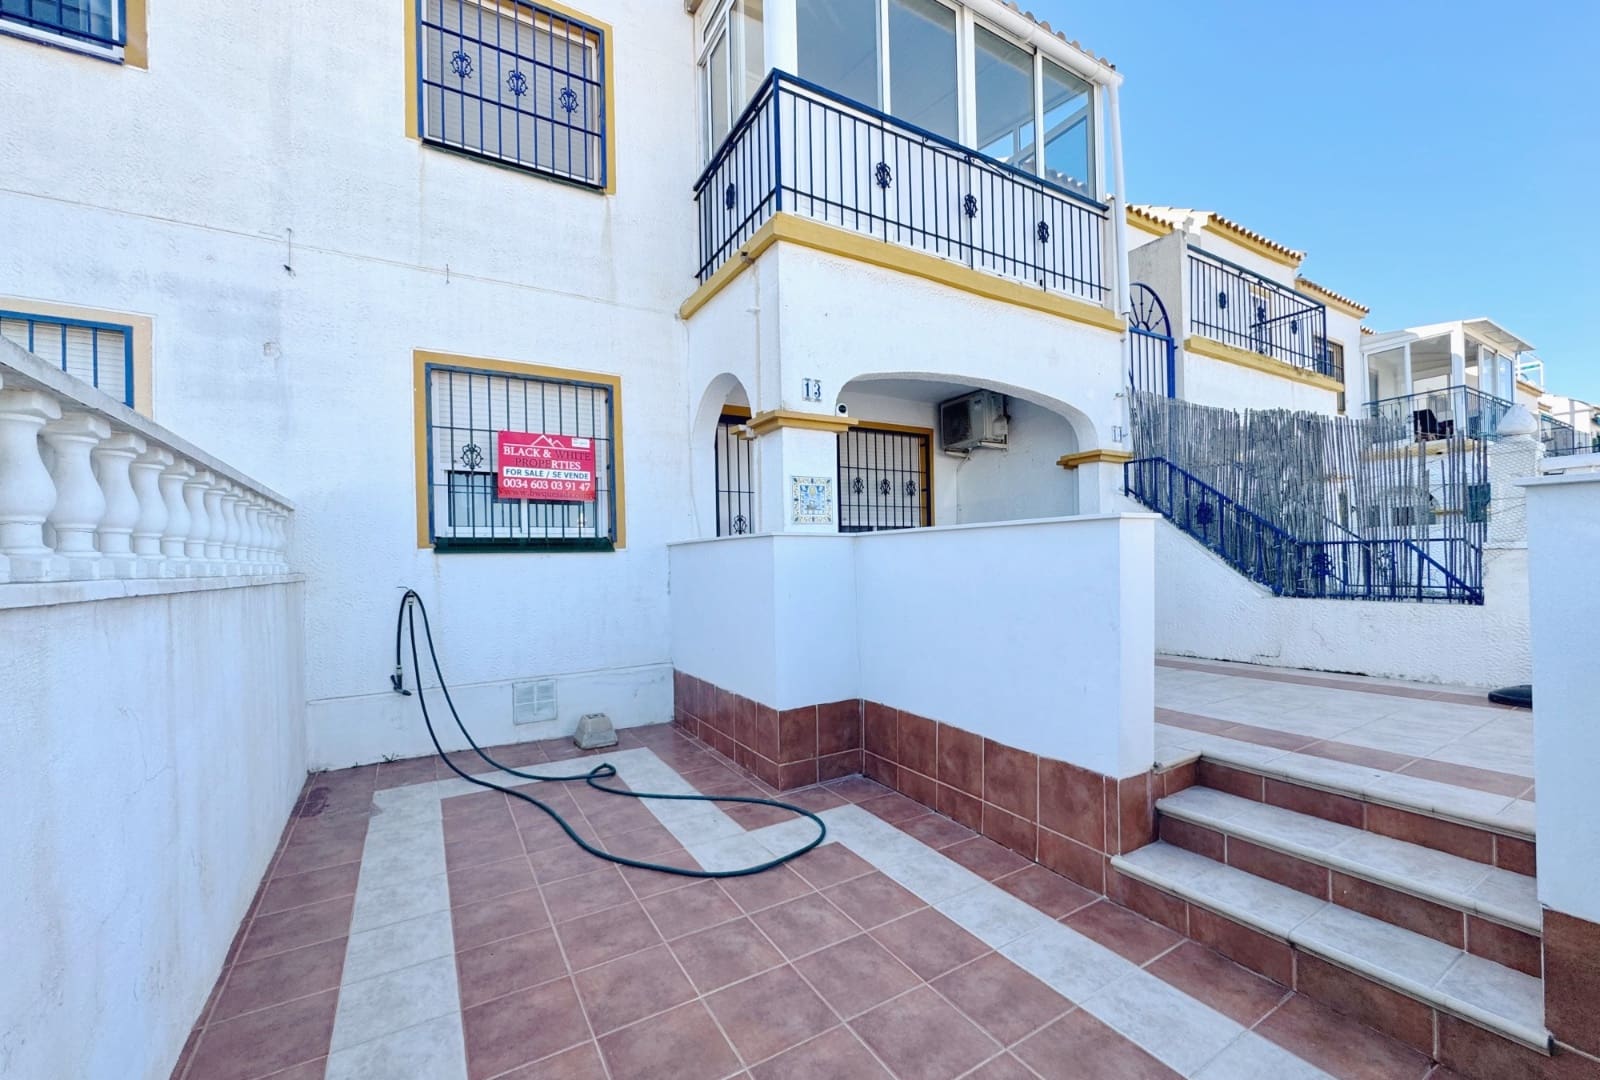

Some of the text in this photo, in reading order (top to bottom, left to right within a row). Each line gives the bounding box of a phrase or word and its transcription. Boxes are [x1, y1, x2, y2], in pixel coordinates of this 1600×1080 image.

[804, 381, 821, 398] 13
[503, 446, 591, 461] BLACK & WHITE
[515, 458, 581, 470] PROPERTIES
[505, 468, 522, 476] FOR
[524, 469, 544, 477] SALE
[564, 472, 589, 480] VENDE
[503, 478, 591, 491] 0034 603 03 91 47
